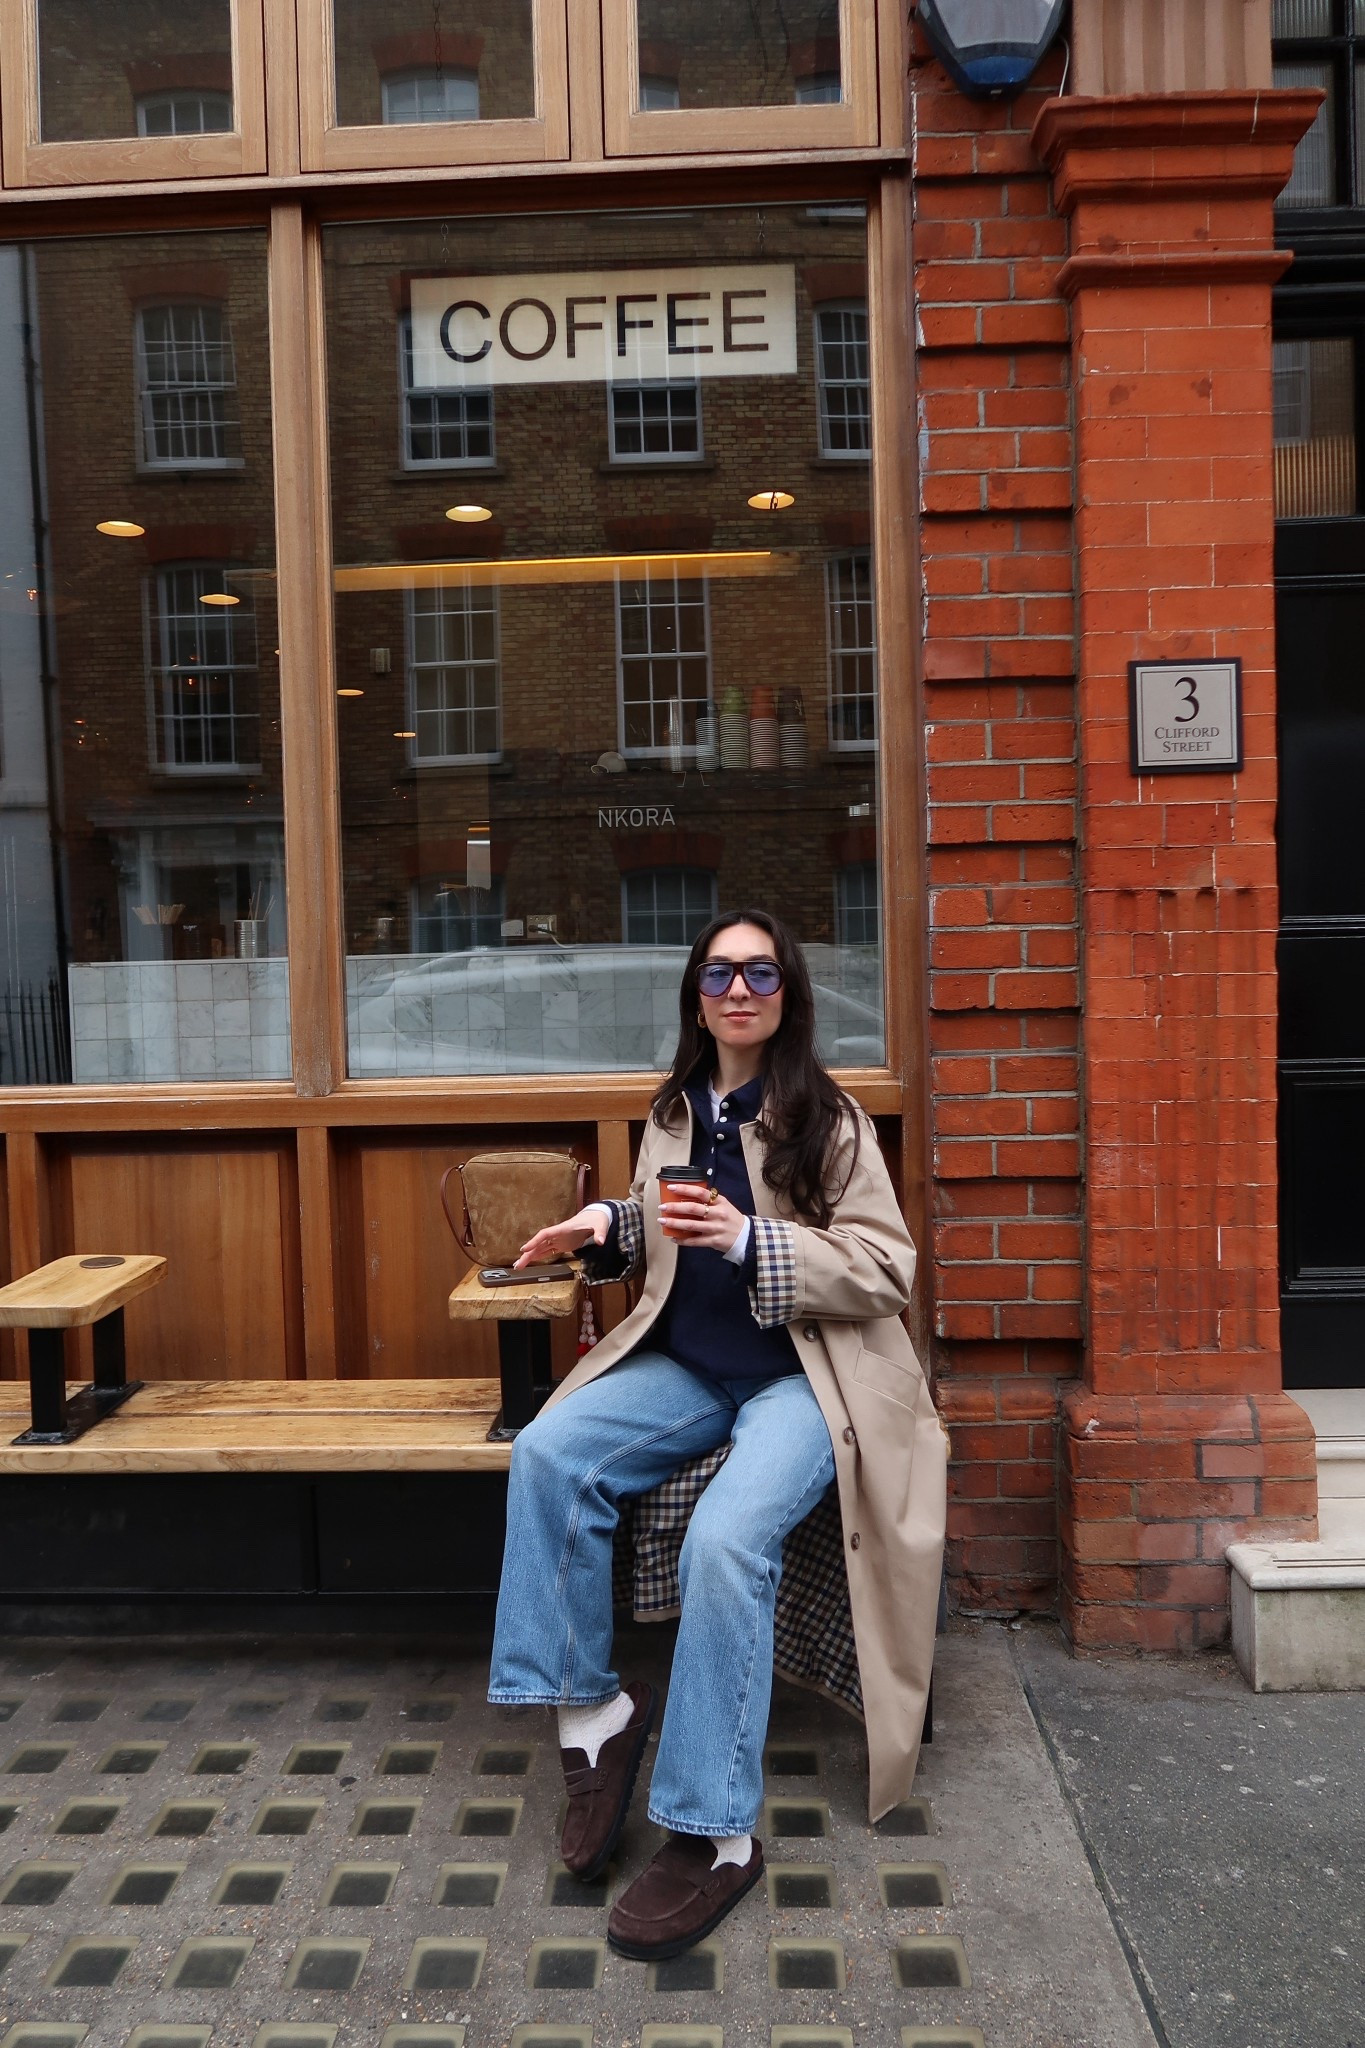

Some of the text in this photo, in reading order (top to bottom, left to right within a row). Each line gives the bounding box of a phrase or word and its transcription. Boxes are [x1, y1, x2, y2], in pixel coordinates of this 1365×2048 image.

[439, 289, 769, 363] COFFEE
[1174, 676, 1200, 723] 3
[1154, 727, 1220, 739] CLIFFORD
[1163, 741, 1212, 753] STREET
[598, 808, 676, 828] NKORA
